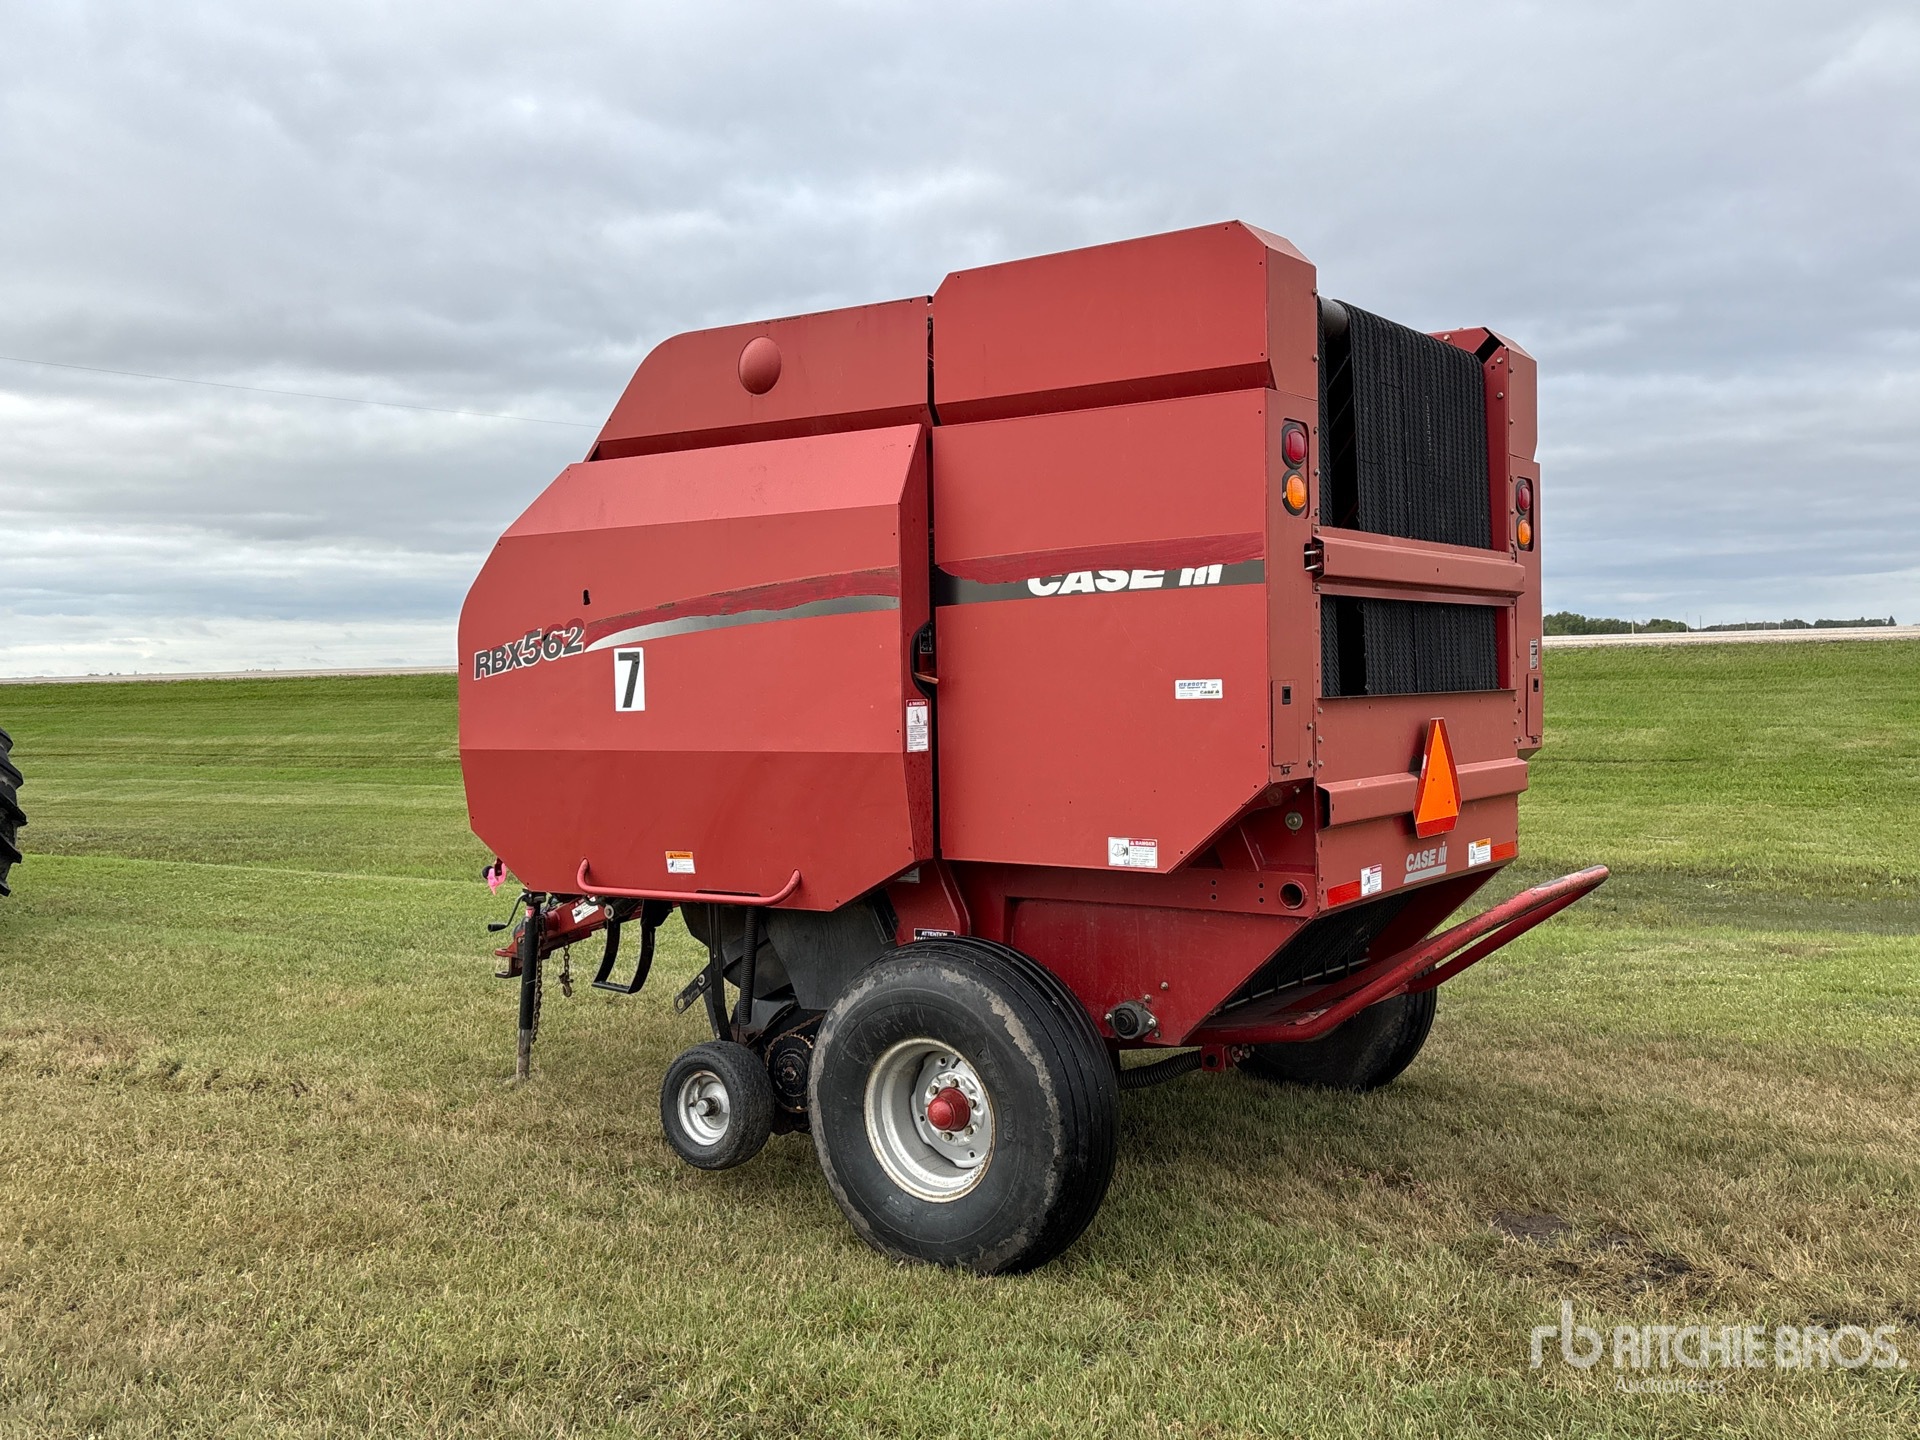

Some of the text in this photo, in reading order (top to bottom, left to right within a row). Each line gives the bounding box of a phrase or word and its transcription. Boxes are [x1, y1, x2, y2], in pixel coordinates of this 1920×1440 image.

[1028, 569, 1165, 597] CASE
[474, 626, 585, 681] RBX562
[618, 652, 640, 708] 7
[1406, 848, 1437, 872] CASE
